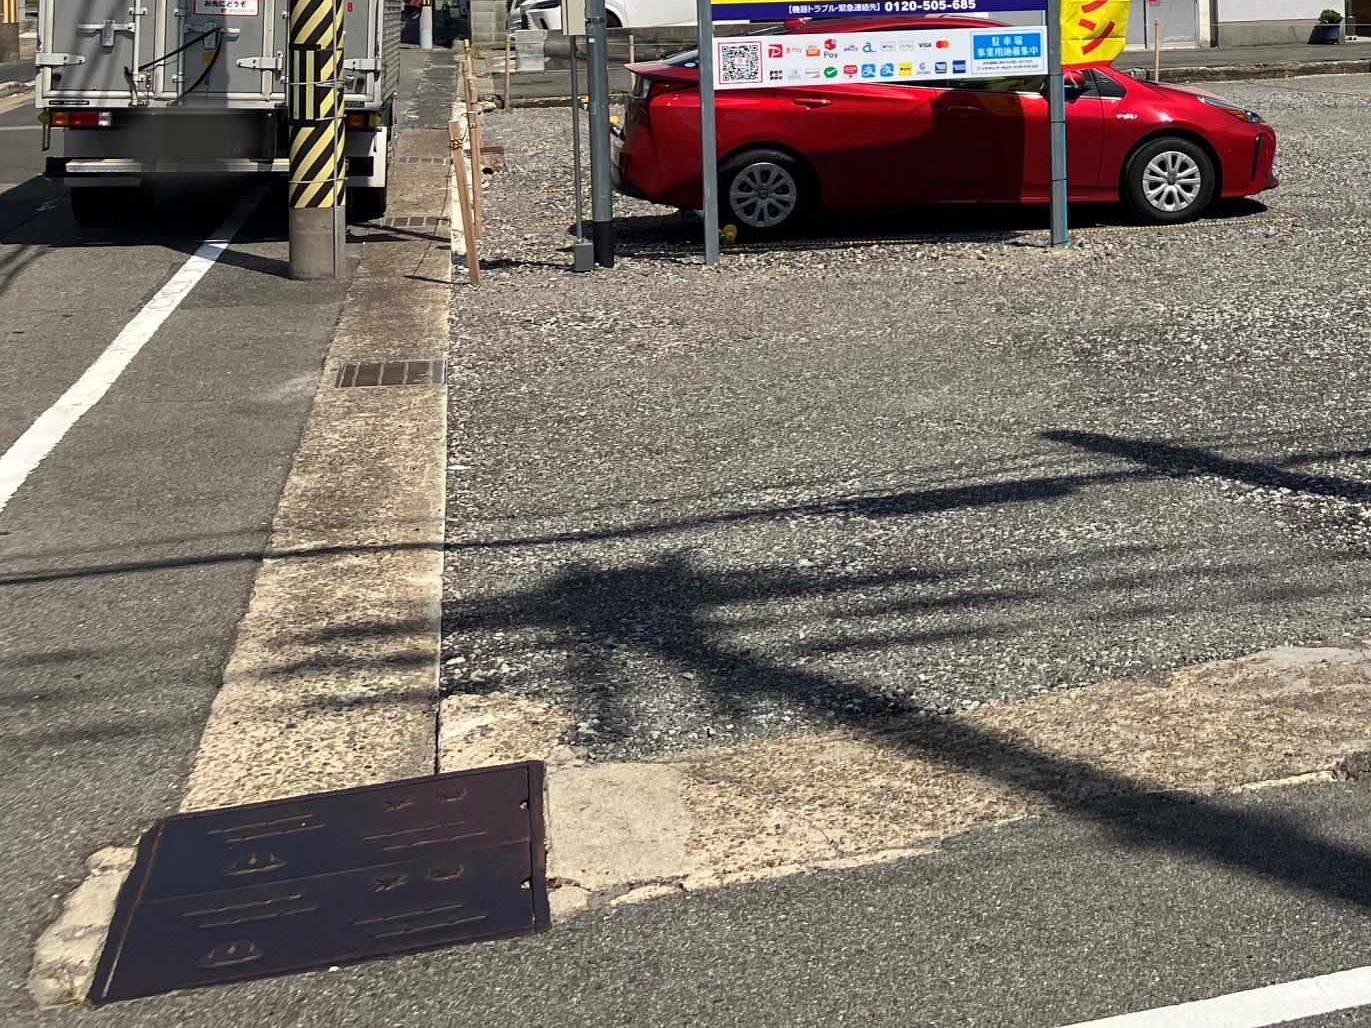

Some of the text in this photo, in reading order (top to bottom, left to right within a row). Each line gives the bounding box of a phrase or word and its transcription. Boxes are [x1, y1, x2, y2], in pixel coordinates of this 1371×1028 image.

[204, 0, 247, 8] お先にどうぞ
[885, 0, 976, 12] 0120-505-685
